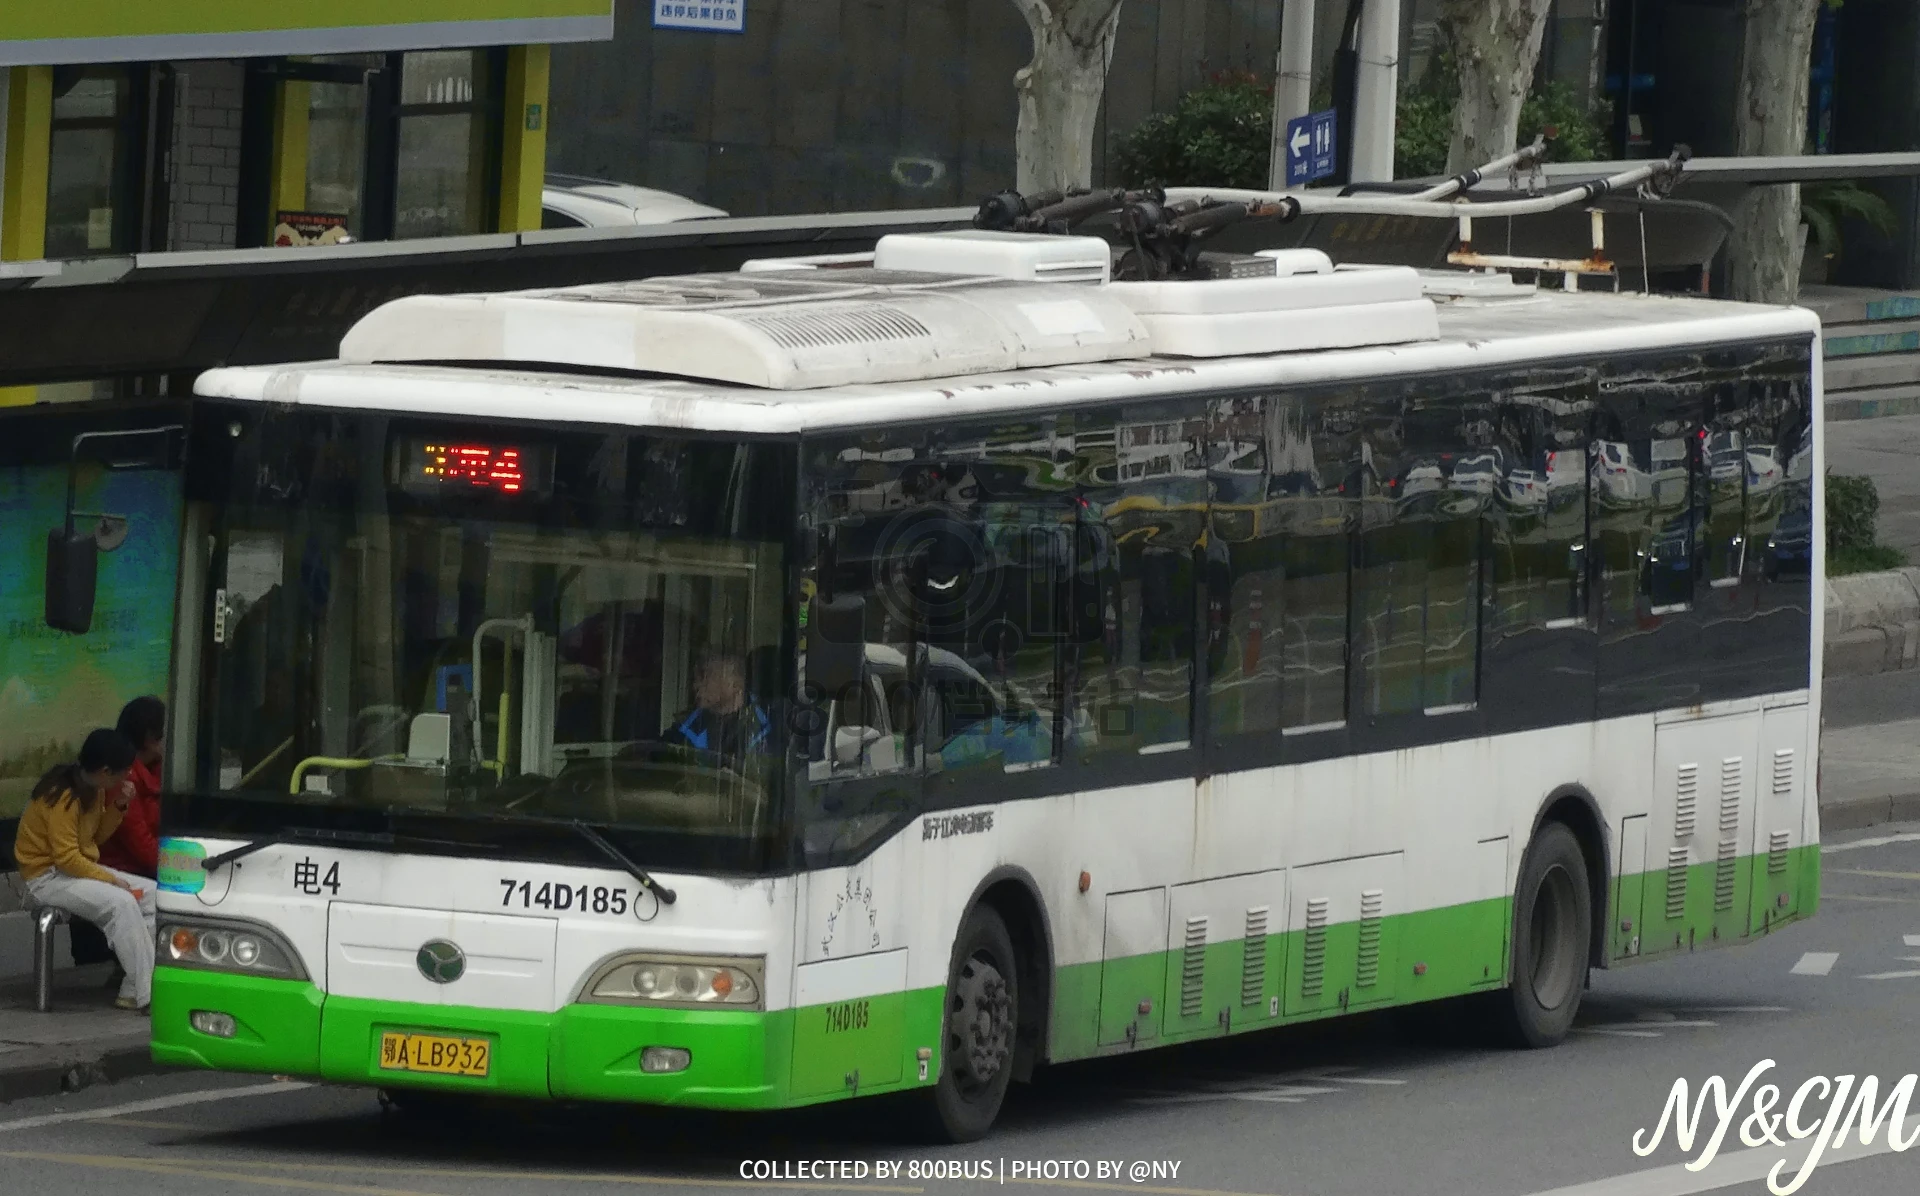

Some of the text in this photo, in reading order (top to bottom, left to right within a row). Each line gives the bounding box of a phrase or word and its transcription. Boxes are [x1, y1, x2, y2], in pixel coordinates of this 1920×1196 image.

[661, 5, 737, 20] 违停后果自负
[294, 856, 342, 896] 电4
[500, 878, 628, 915] 714D185
[825, 1001, 870, 1035] 714D185
